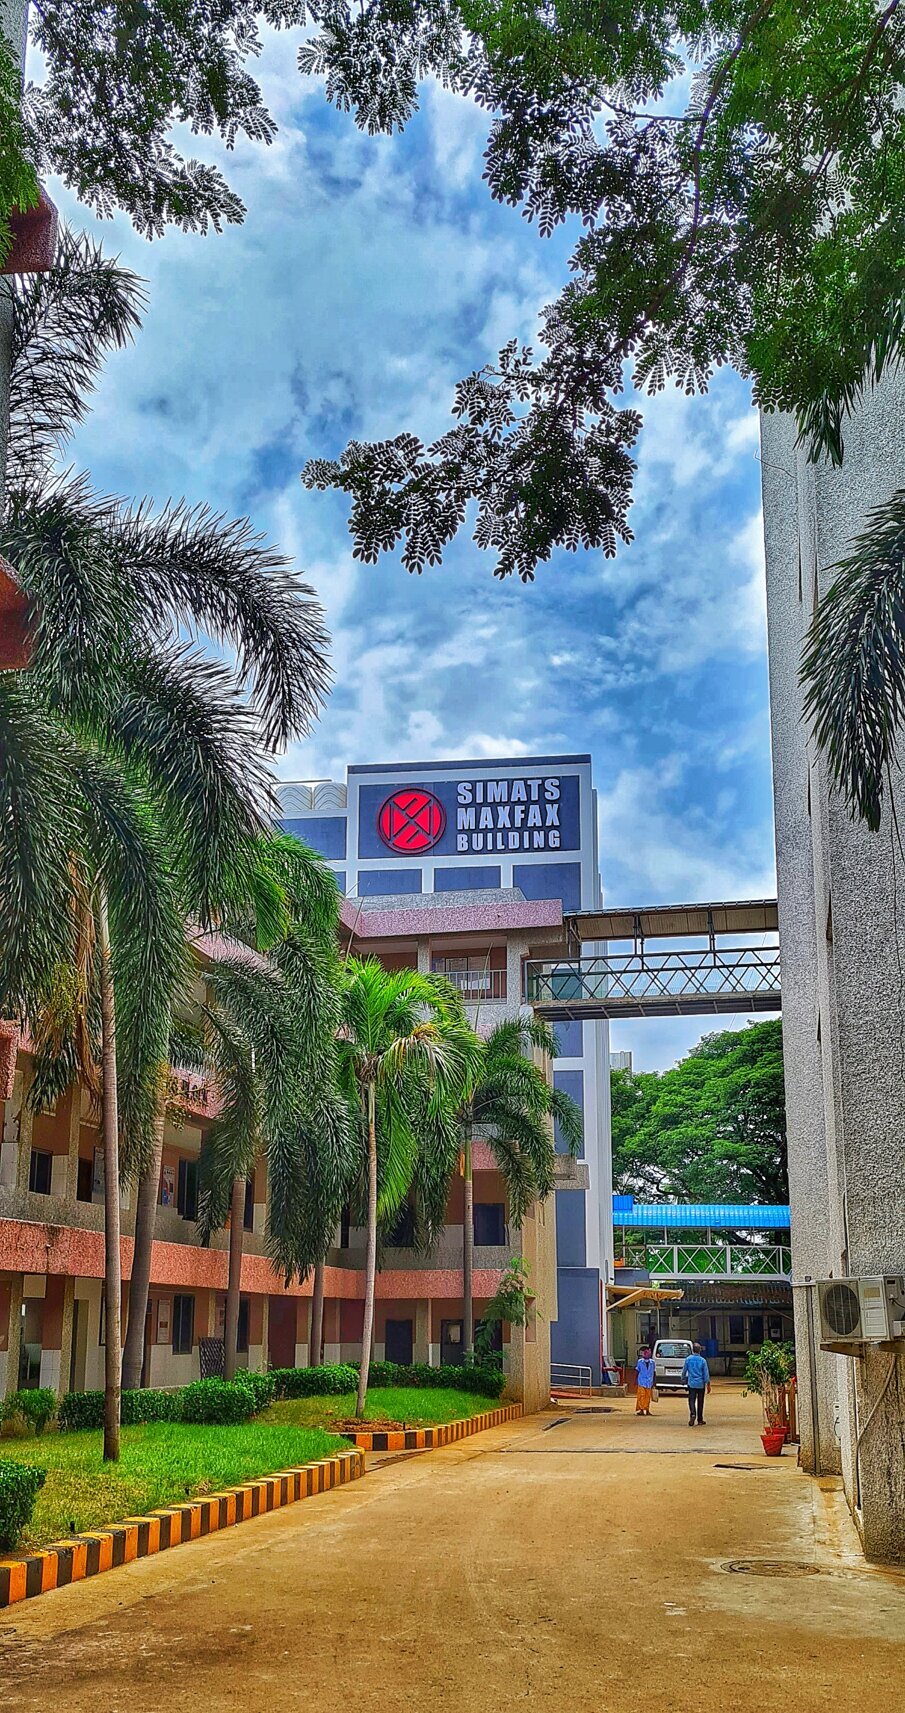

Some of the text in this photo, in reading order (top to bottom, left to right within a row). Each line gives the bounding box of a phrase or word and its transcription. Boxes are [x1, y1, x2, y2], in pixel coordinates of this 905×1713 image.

[457, 779, 560, 804] SIMATS
[457, 804, 560, 830] MAXFAX
[457, 830, 560, 852] BUILDING
